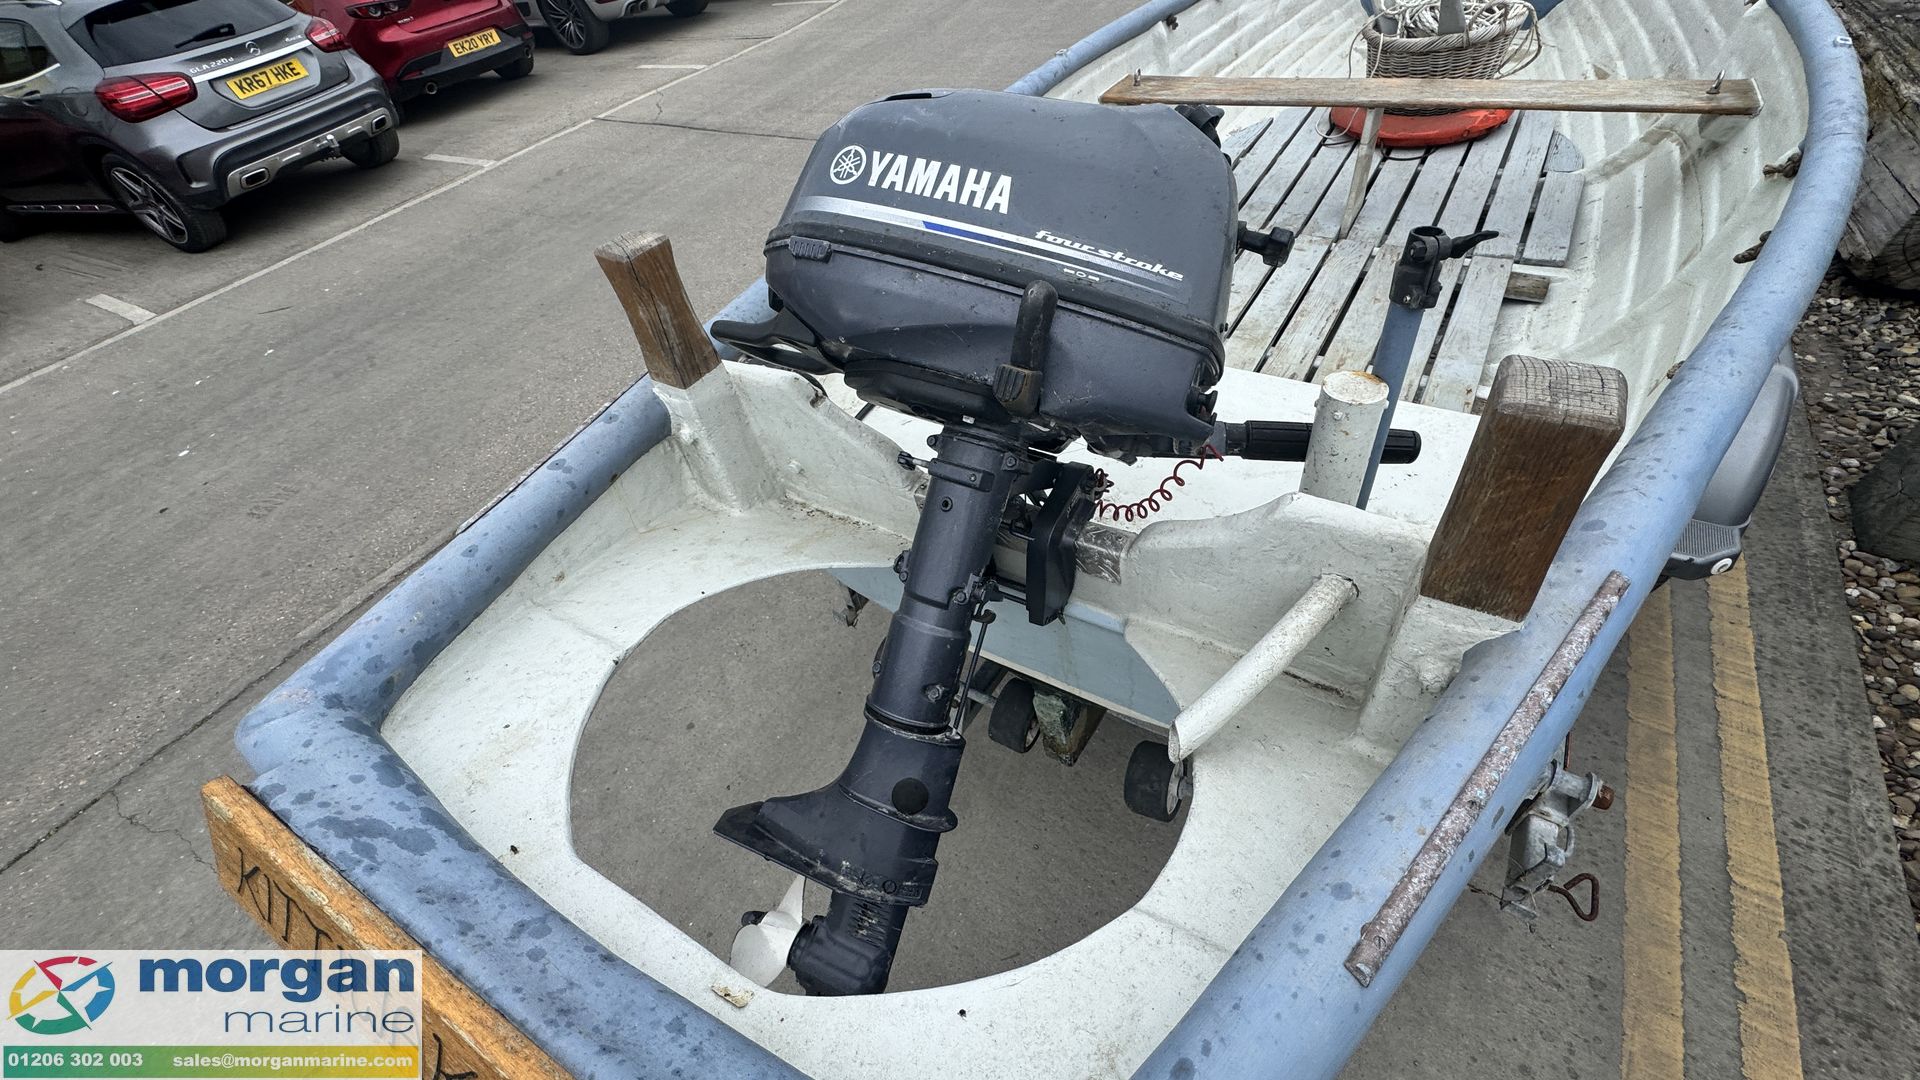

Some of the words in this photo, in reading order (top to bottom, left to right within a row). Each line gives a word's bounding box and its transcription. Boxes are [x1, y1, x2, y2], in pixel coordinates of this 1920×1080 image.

[452, 38, 478, 54] EK20
[477, 32, 496, 47] YRY
[189, 64, 210, 74] GLA
[234, 71, 273, 94] KR67
[270, 62, 301, 82] HKE
[868, 150, 1012, 215] YAMAHA
